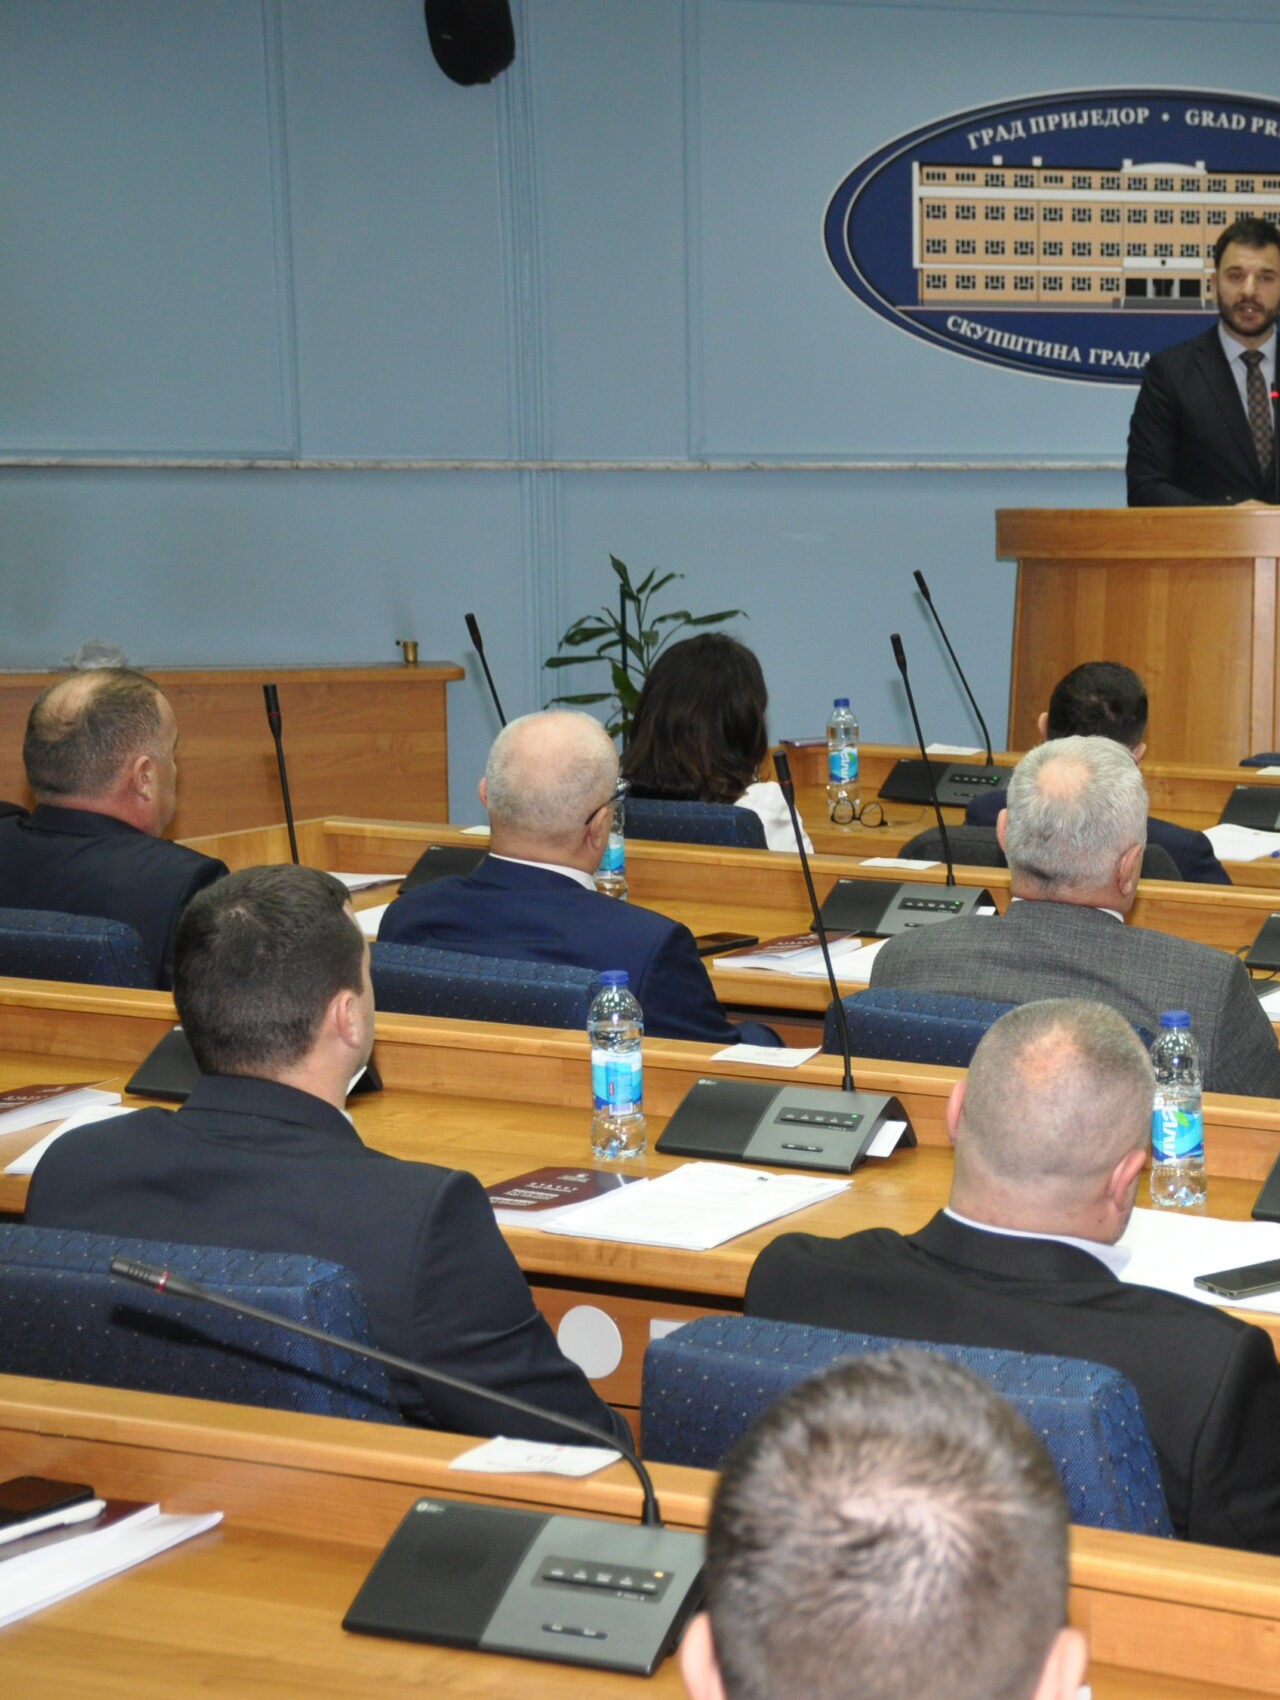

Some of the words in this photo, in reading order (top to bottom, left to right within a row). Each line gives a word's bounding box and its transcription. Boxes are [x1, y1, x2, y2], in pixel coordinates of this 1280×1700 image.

[967, 120, 1026, 150] ГРАД
[1029, 107, 1150, 134] ПРИЈЕДОР
[1185, 108, 1246, 131] GRAD
[946, 314, 1082, 363] СКУПШТИНА
